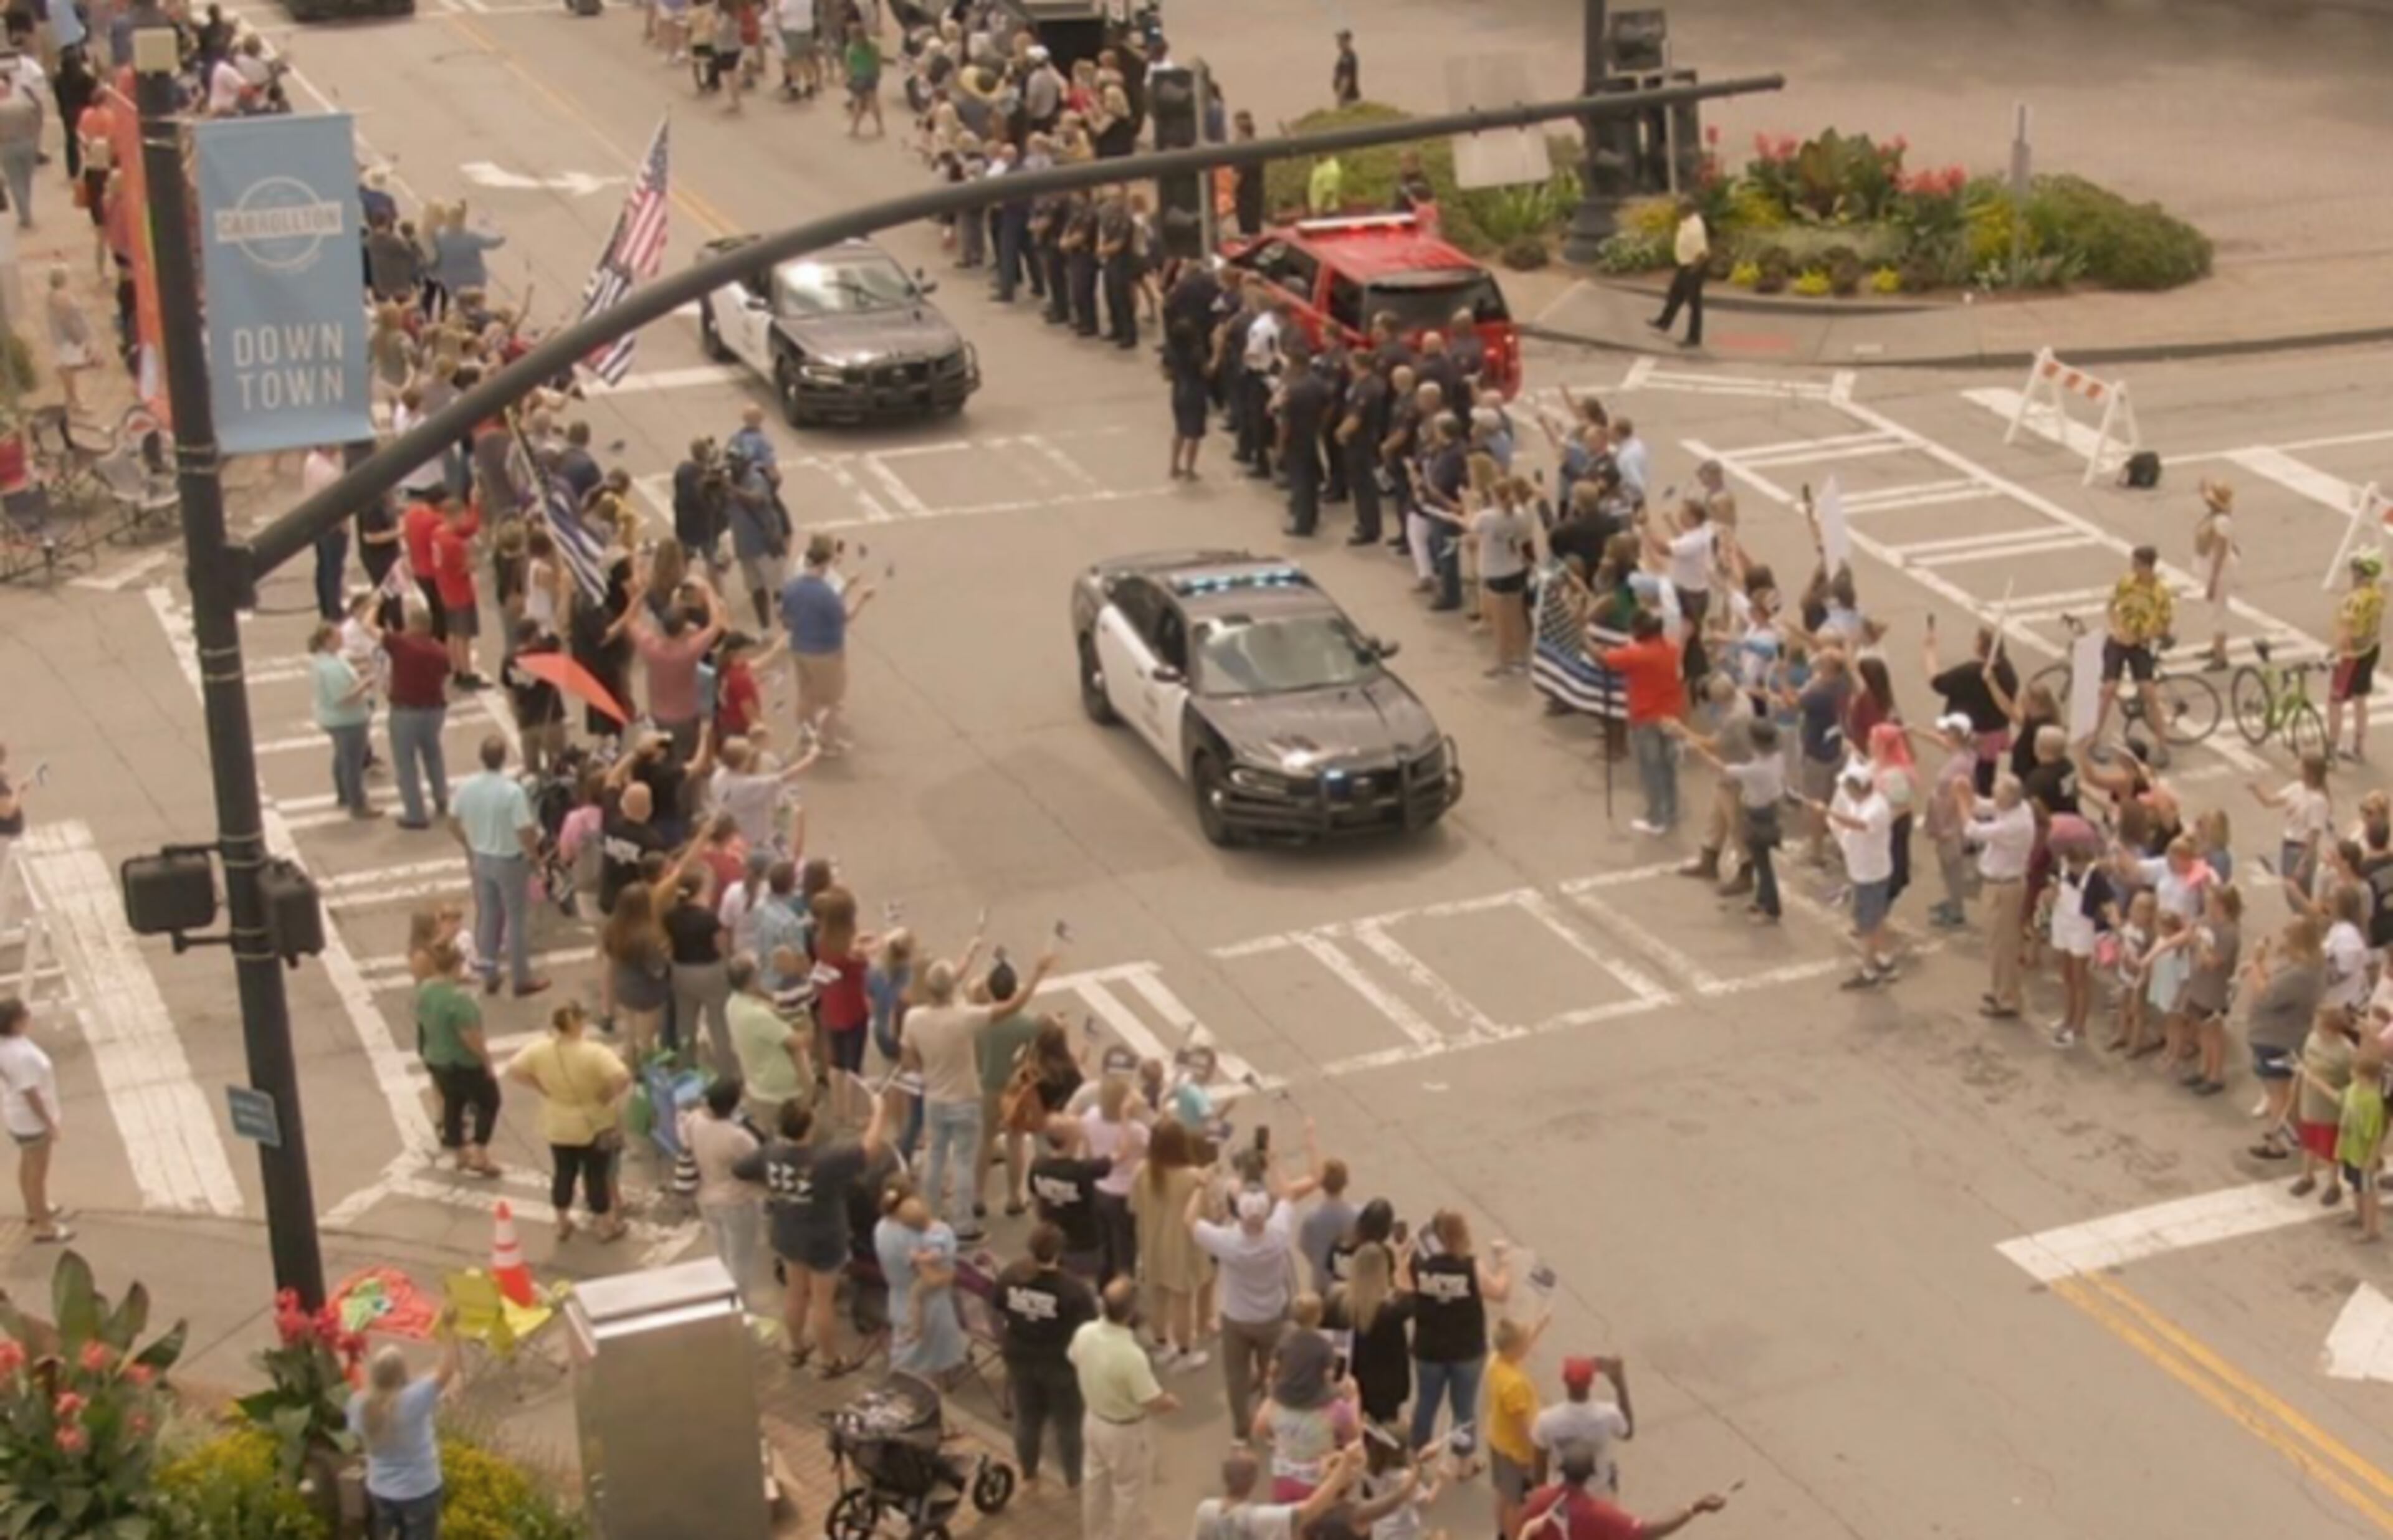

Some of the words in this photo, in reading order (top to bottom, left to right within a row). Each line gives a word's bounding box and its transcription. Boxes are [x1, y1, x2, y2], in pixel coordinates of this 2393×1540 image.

[218, 204, 340, 235] CARROLLTON
[234, 322, 343, 367] DOWN
[236, 365, 343, 411] TOWN
